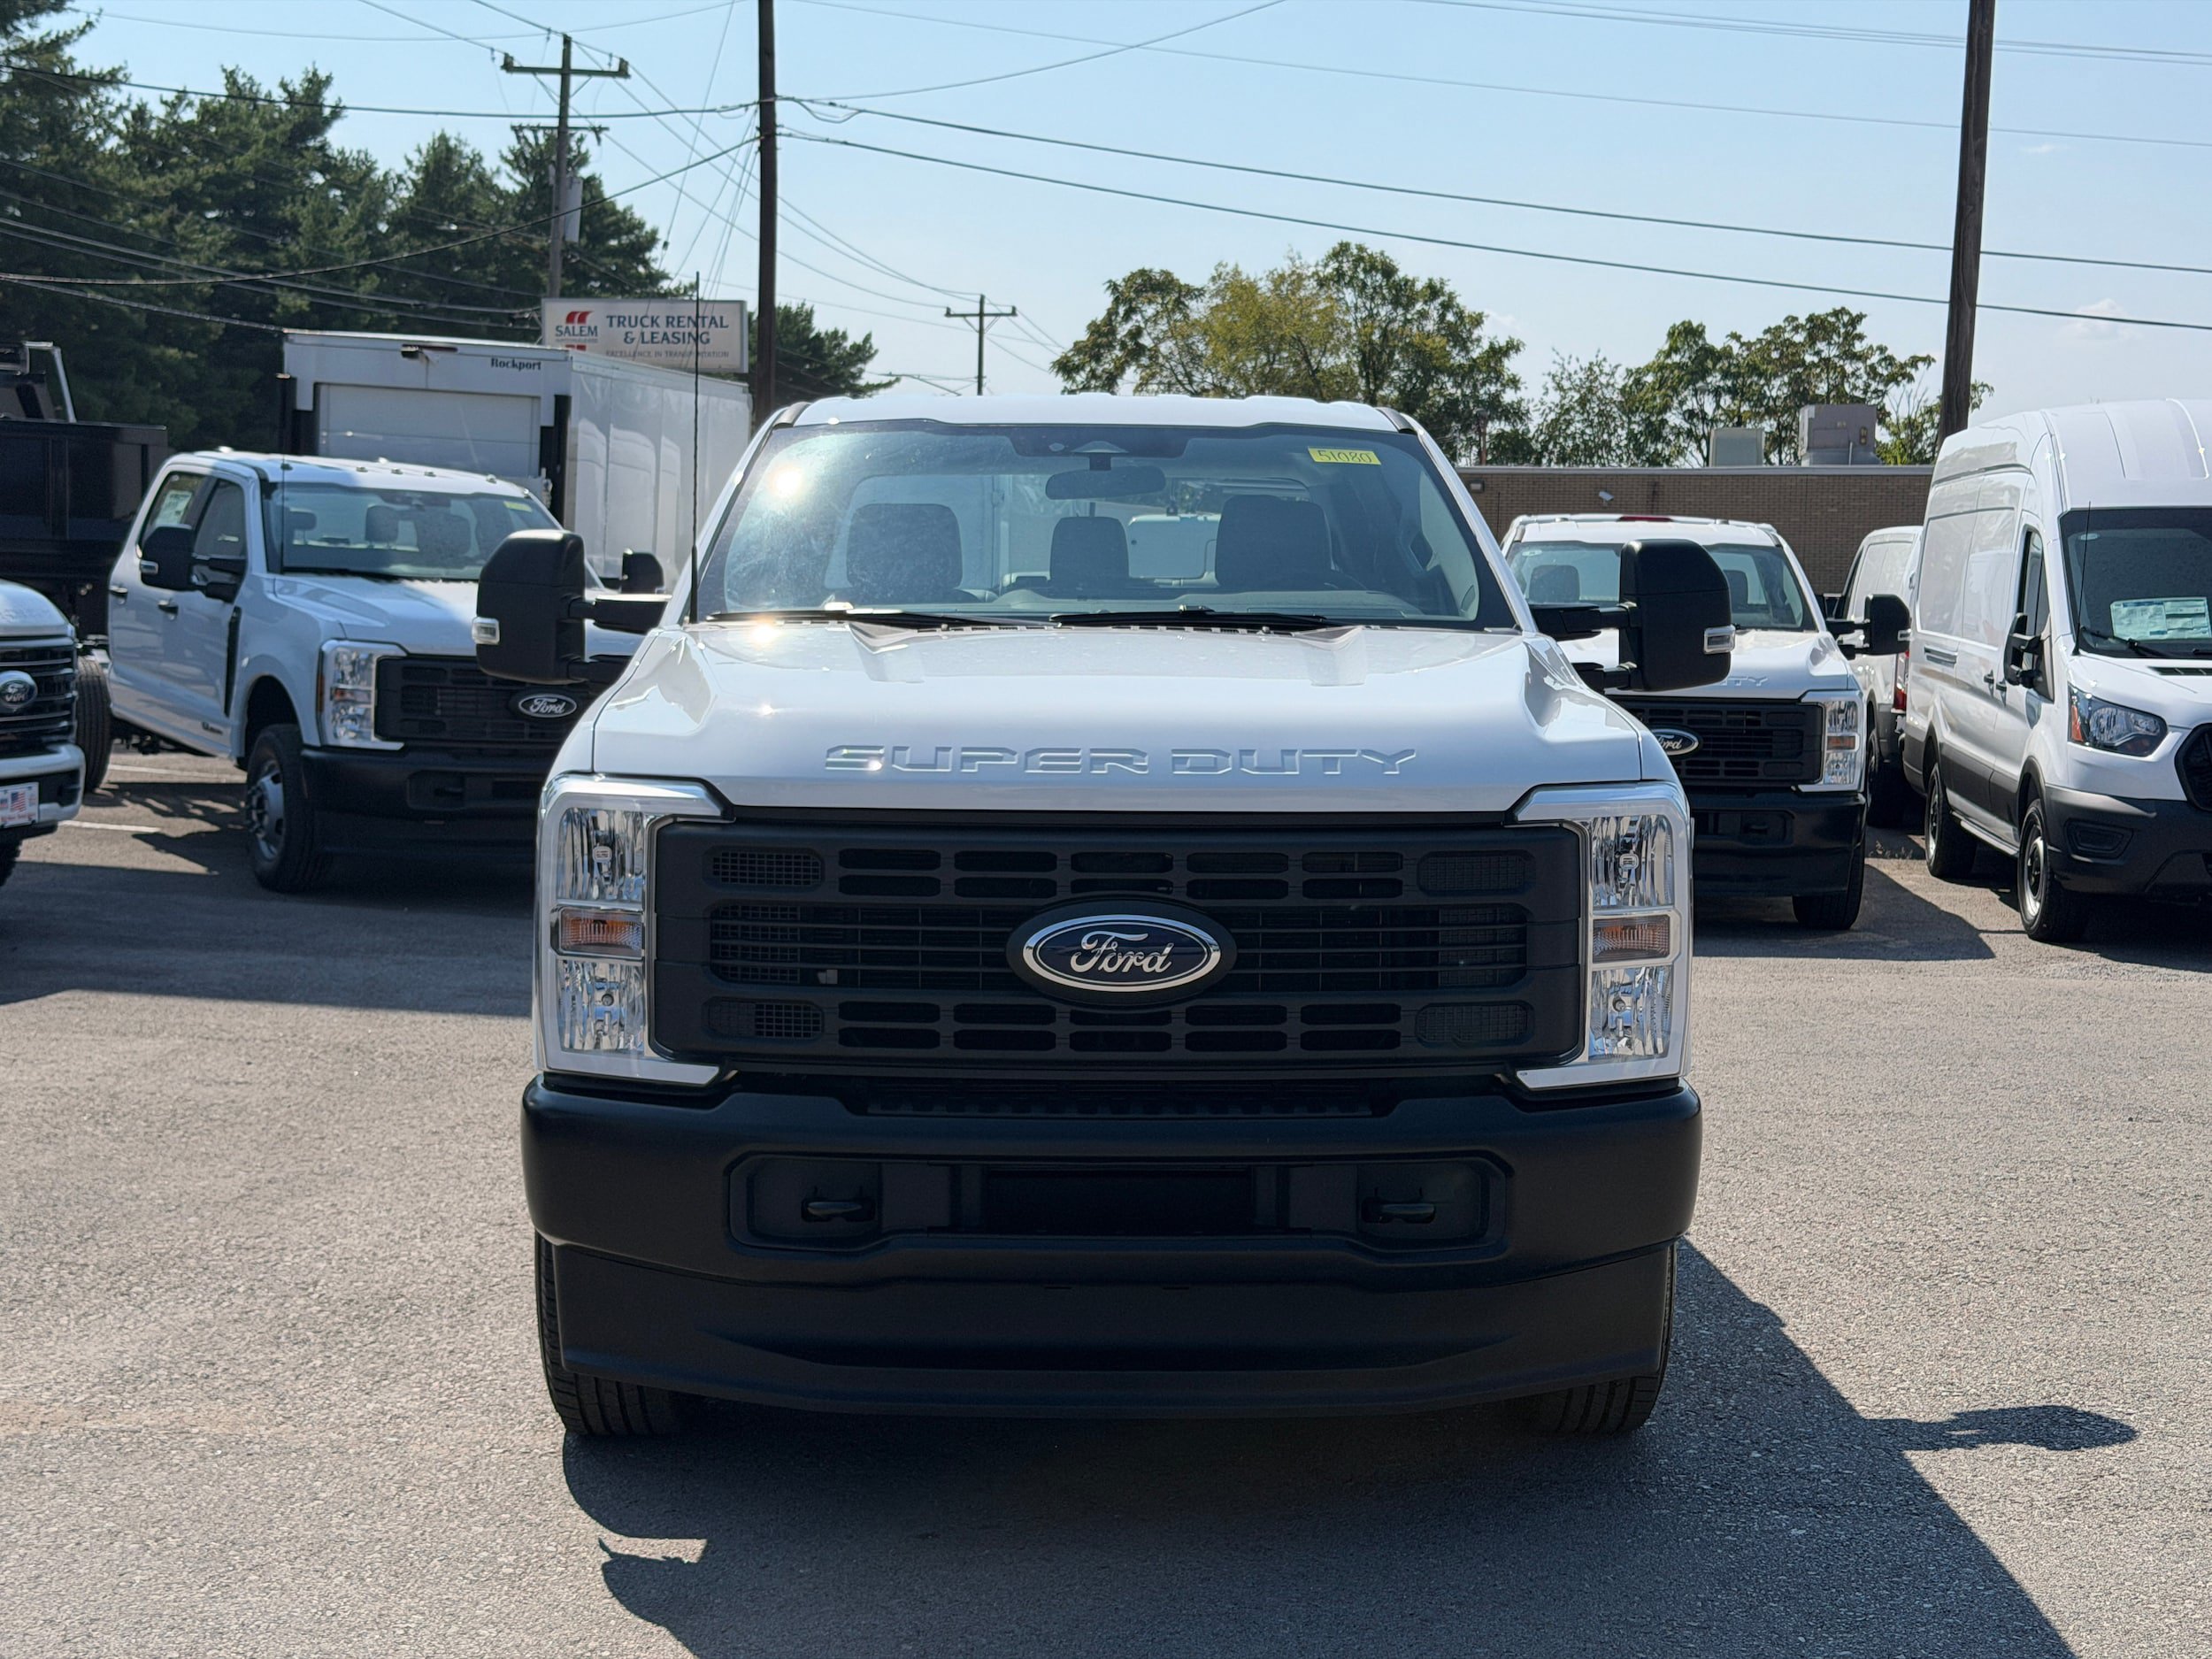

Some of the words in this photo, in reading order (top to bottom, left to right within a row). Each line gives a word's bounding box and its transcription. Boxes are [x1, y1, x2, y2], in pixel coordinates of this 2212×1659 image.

[606, 315, 660, 328] TRUCK
[665, 315, 729, 328] RENTAL
[556, 325, 598, 337] SALEM
[624, 331, 635, 344] &
[641, 331, 710, 344] LEASING
[491, 357, 541, 372] Rockport
[1317, 449, 1372, 463] 51080
[530, 697, 565, 713] Ford
[825, 744, 1149, 774] SUPER
[1171, 749, 1417, 775] DUTY
[1070, 930, 1175, 974] Ford
